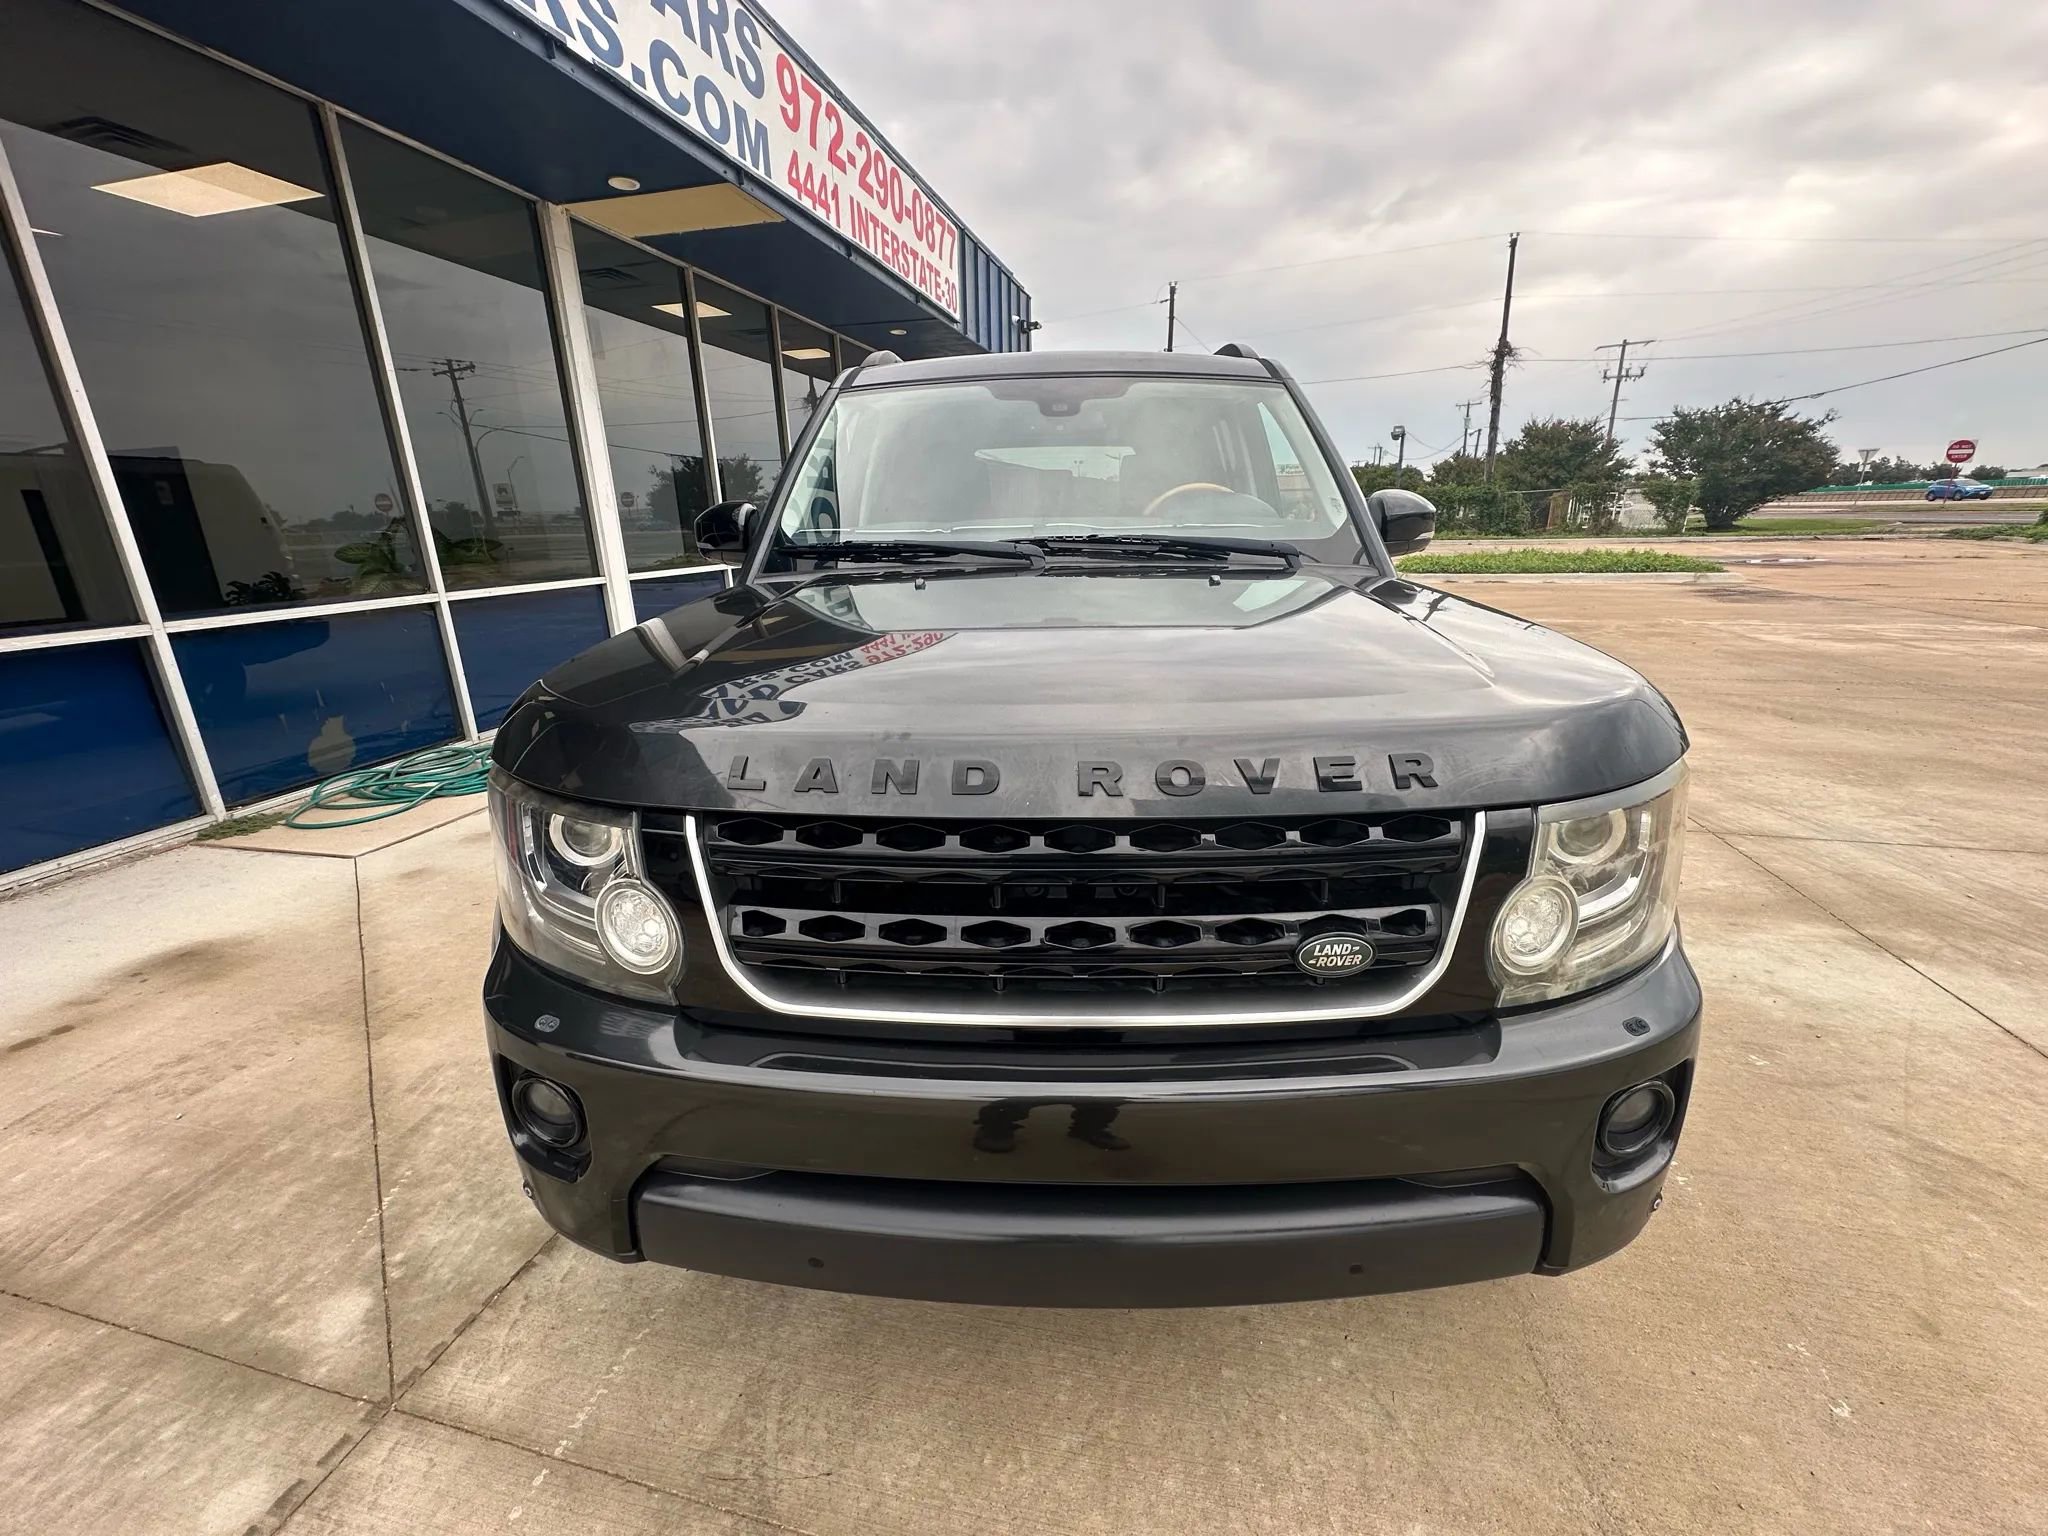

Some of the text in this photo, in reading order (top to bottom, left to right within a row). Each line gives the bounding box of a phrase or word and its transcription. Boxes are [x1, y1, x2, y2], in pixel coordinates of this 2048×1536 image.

[776, 53, 957, 270] 972-290-0877
[787, 149, 958, 314] 4441 INTERSTATE-30
[727, 752, 1439, 797] LAND ROVER
[1313, 943, 1352, 957] LAND
[1315, 954, 1363, 968] ROVER
